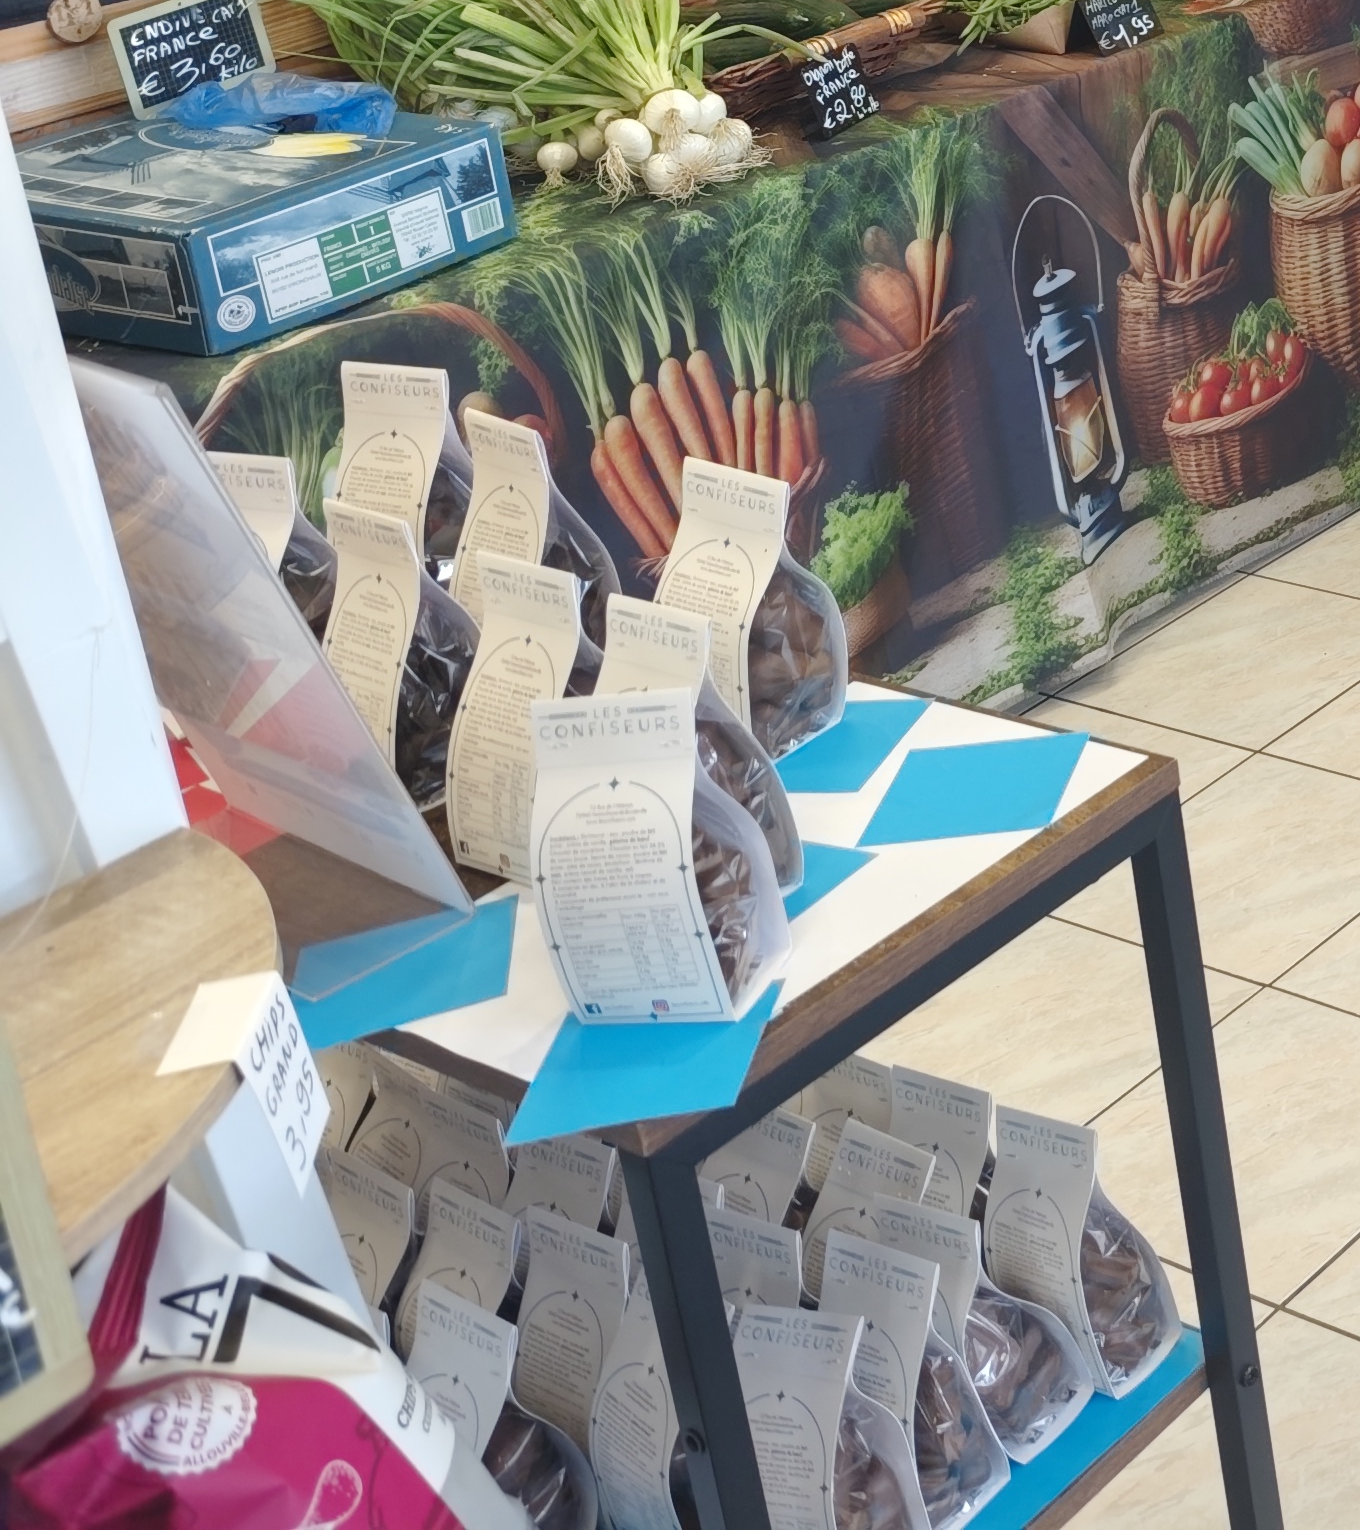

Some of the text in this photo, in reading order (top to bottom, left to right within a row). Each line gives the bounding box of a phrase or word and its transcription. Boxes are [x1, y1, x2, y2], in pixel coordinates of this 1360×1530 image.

[1112, 13, 1154, 48] 1,95
[170, 43, 241, 93] 3,60
[349, 381, 441, 399] CONFISEURS
[383, 374, 403, 383] LES
[687, 481, 775, 515] CONFISEURS
[722, 479, 741, 491] LES
[483, 577, 569, 609] CONFISEURS
[513, 574, 532, 585] LES
[610, 619, 698, 653] CONFISEURS
[644, 614, 663, 628] LES
[540, 716, 681, 740] CONFISEURS
[593, 707, 620, 719] LES
[266, 1023, 298, 1116] GRAND
[893, 1087, 979, 1123] CONFISEURS
[1000, 1129, 1087, 1162] CONFISEURS
[1032, 1127, 1052, 1140] LES
[840, 1147, 918, 1188] CONFISEURS
[880, 1214, 970, 1253] CONFISEURS
[829, 1255, 925, 1299] CONFISEURS
[741, 1324, 845, 1352] CONFISEURS
[786, 1317, 808, 1329] LES
